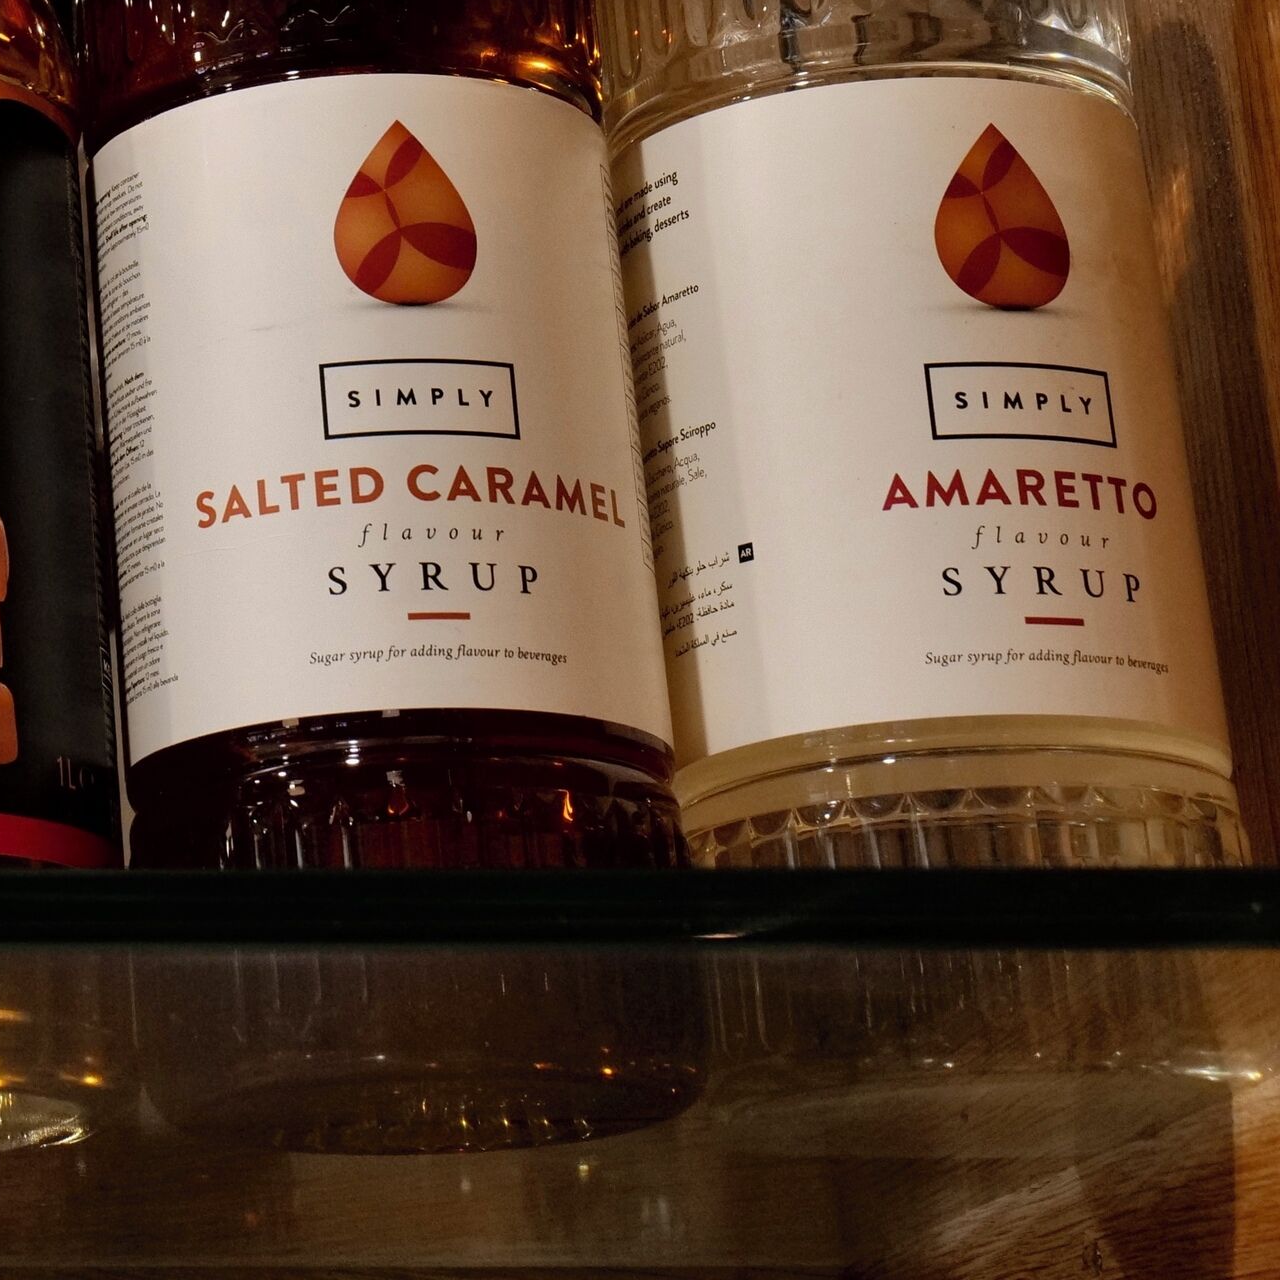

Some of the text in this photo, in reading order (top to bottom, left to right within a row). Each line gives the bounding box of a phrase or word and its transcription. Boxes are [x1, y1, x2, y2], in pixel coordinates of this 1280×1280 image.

[633, 181, 653, 200] made
[654, 171, 679, 189] using
[646, 195, 672, 216] create
[654, 209, 690, 233] desserts
[642, 301, 661, 318] Sabor
[661, 283, 700, 308] Amaretto
[656, 319, 678, 337] Agua,
[347, 387, 493, 409] SIMPLY
[954, 391, 1092, 416] SIMPLY
[657, 435, 680, 455] Sapore
[679, 421, 717, 441] Sciroppo
[673, 452, 700, 470] Acqua,
[687, 466, 708, 483] Sale,
[195, 466, 385, 529] SALTED
[406, 464, 627, 529] CARAMEL
[881, 467, 1158, 521] AMARETTO
[357, 522, 506, 549] flavour
[970, 525, 1111, 550] flavour
[327, 561, 539, 596] SYRUP
[941, 565, 1141, 602] SYRUP
[309, 644, 568, 667] Sugar syrup for adding flavour to beverages
[924, 648, 1170, 676] Sugar syrup for adding flavour to beverages
